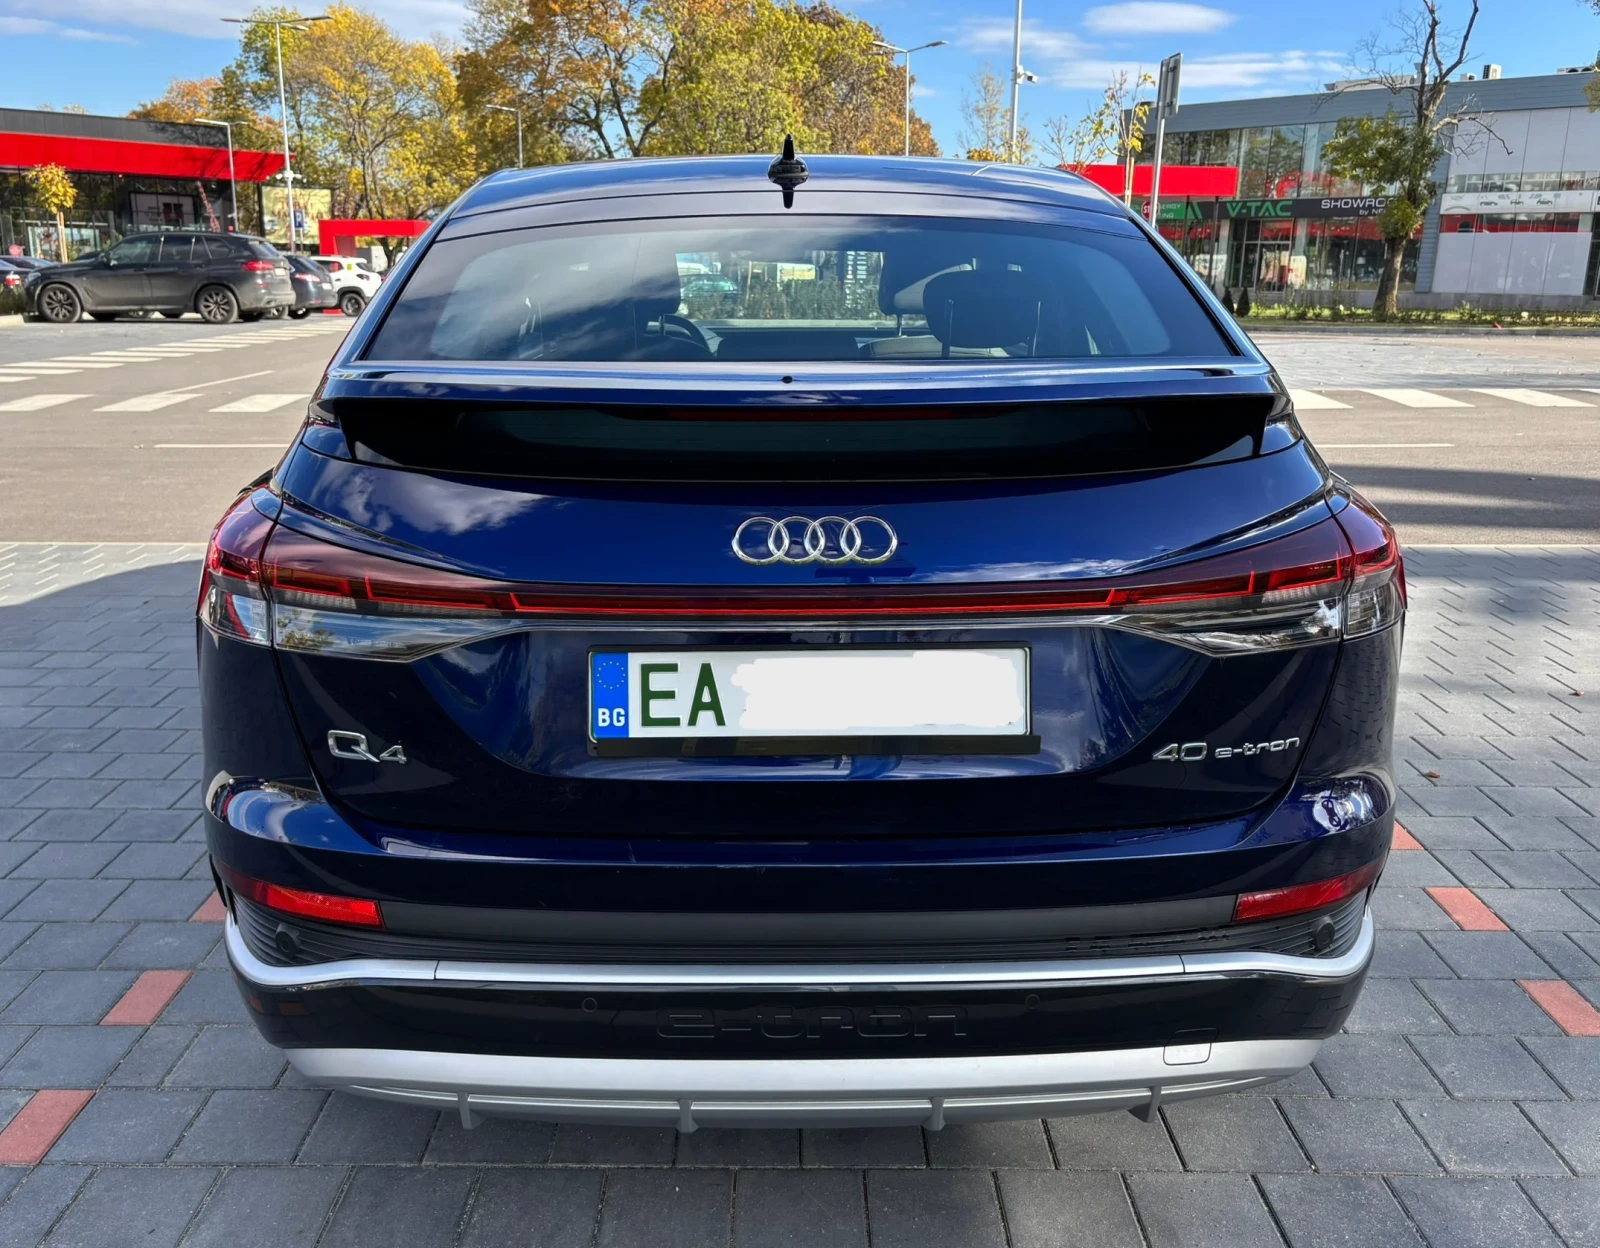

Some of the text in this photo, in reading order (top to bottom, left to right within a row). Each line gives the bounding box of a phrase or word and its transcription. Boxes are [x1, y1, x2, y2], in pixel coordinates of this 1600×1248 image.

[1226, 200, 1292, 217] V-TAC
[597, 707, 626, 727] BG
[327, 729, 407, 764] Q4
[1152, 737, 1300, 762] 40 e-tron
[656, 1005, 967, 1039] e-tron
